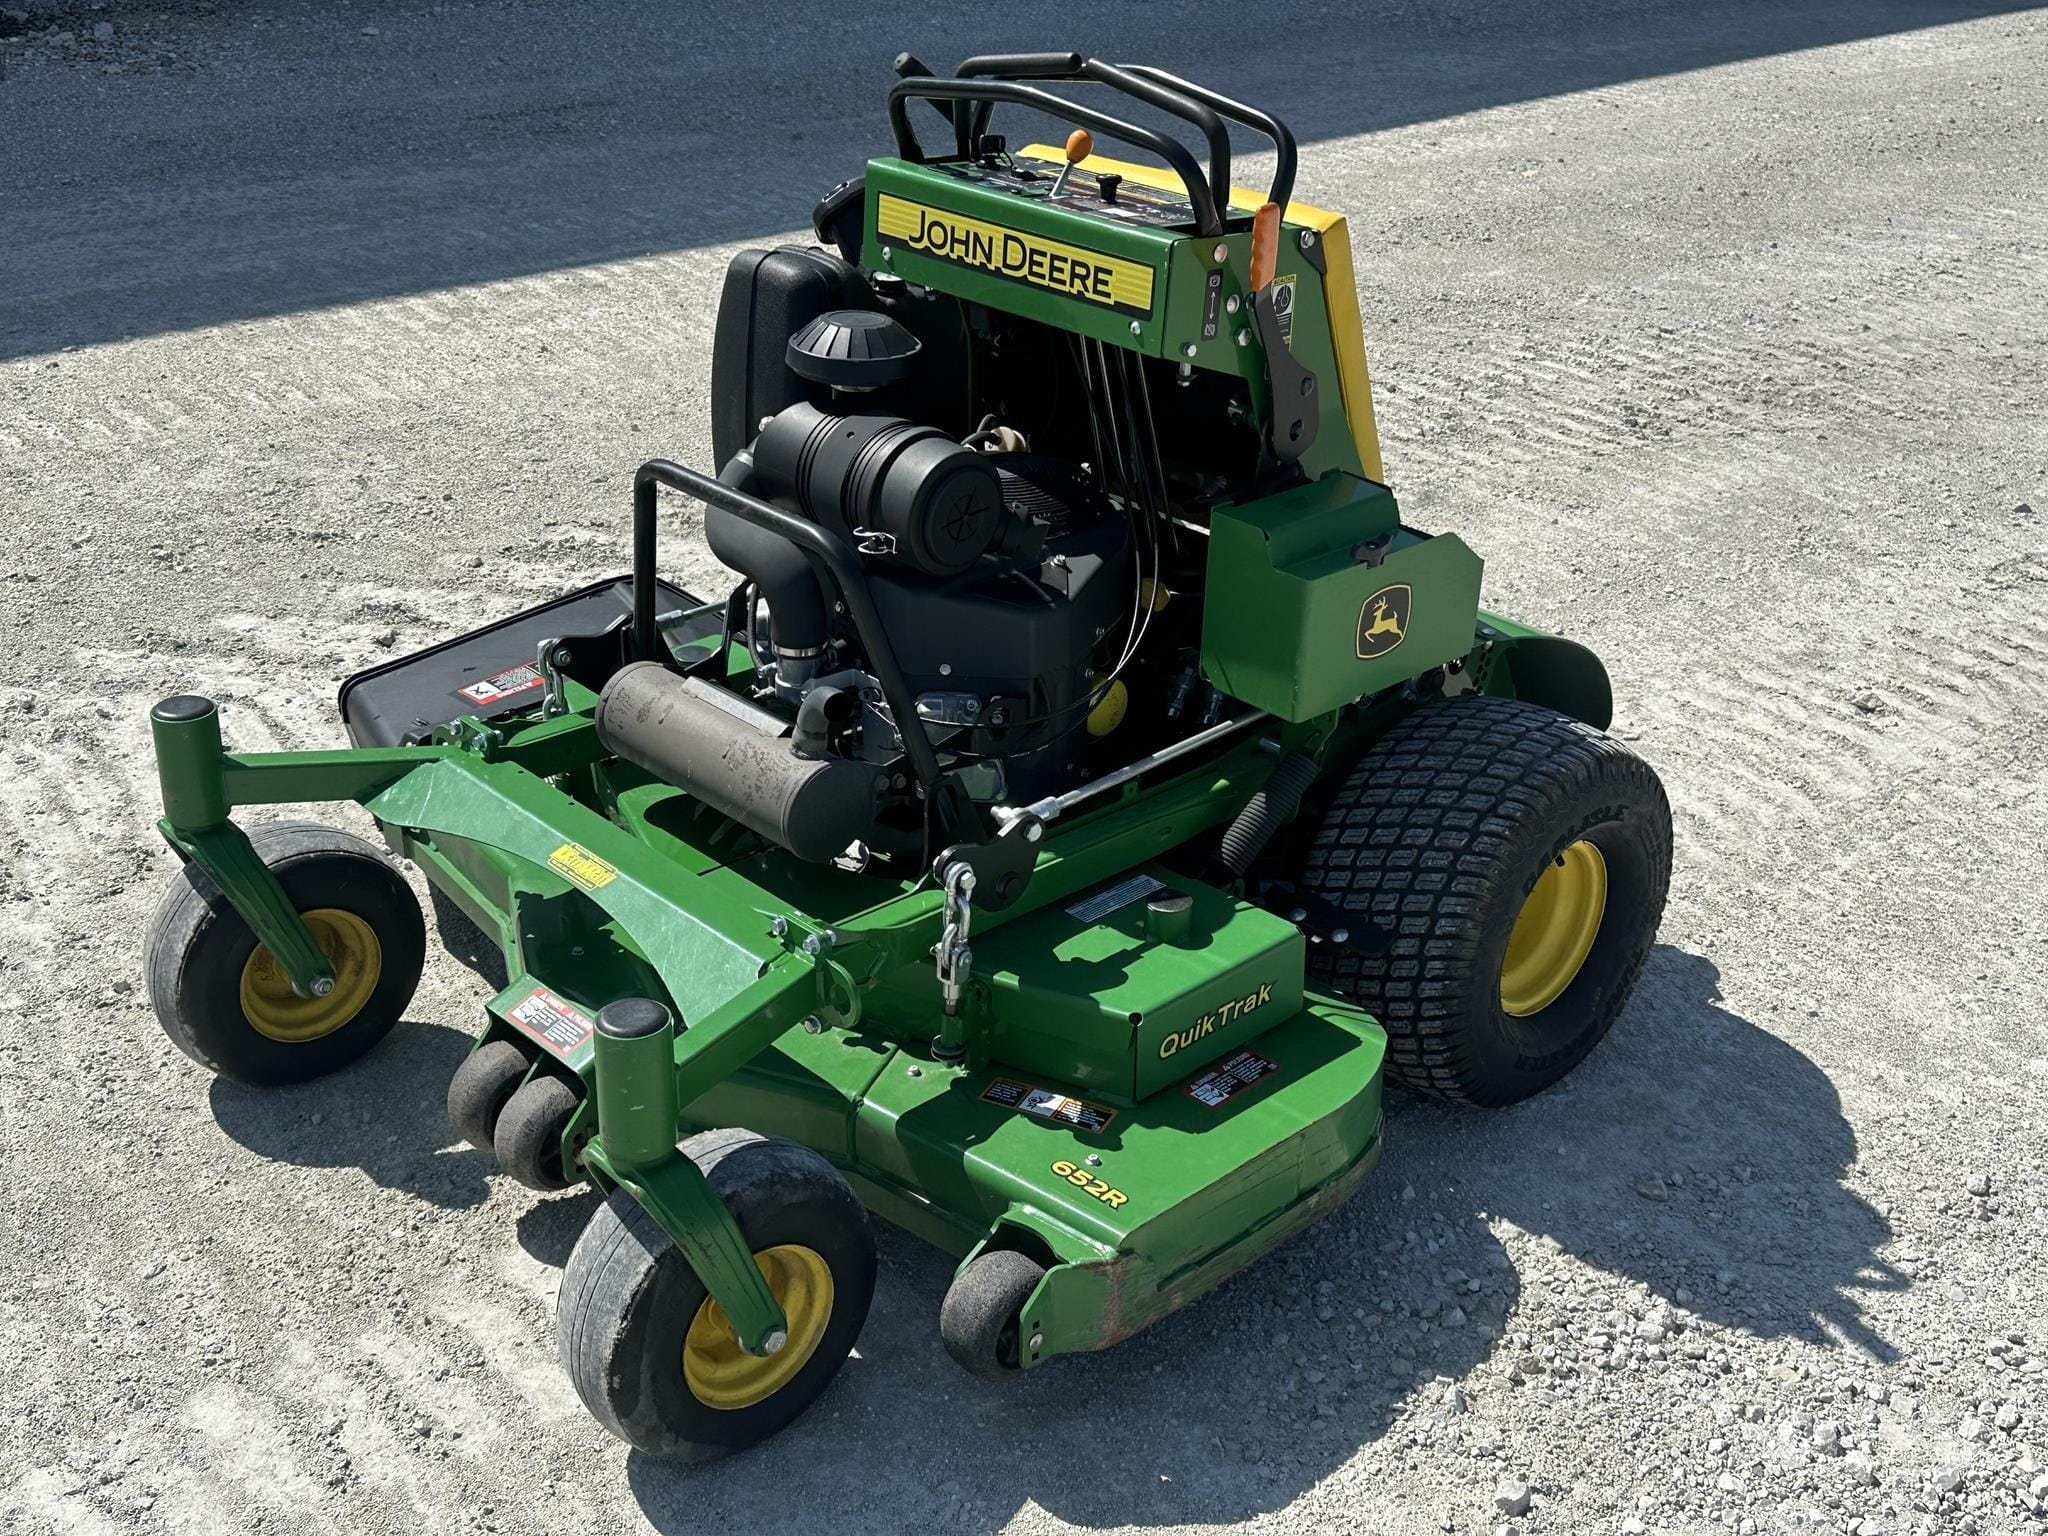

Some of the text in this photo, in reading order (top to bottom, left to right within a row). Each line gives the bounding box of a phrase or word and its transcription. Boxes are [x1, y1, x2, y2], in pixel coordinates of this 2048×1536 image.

[908, 209, 1114, 300] JOHN DEERE
[1050, 1160, 1128, 1210] 652R
